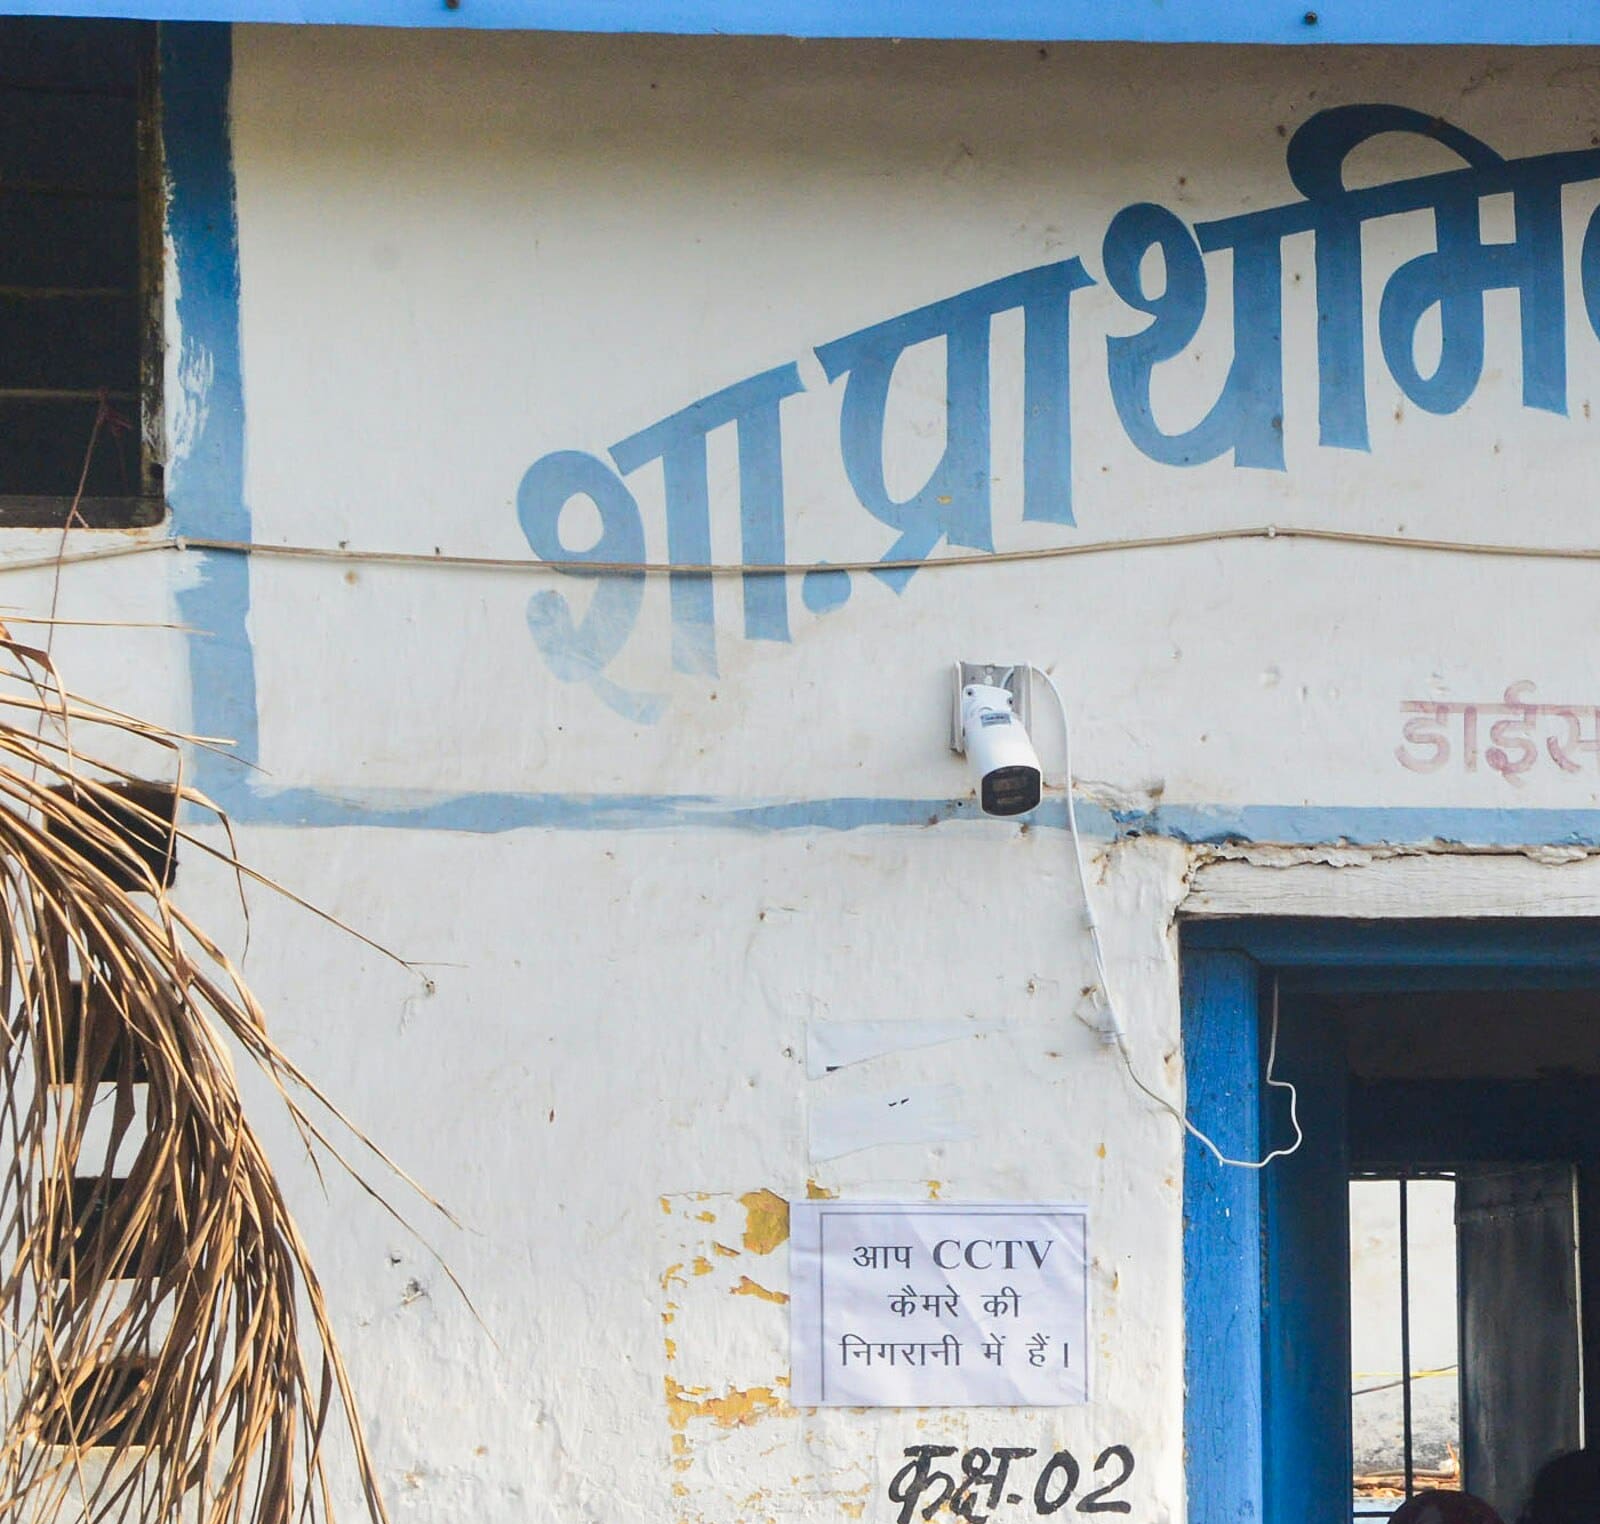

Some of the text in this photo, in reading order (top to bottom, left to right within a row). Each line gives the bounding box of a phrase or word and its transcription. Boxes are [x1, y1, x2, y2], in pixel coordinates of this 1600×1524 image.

[852, 1239, 1054, 1272] आप CCTV
[888, 1284, 1021, 1319] कैमरे की
[840, 1334, 962, 1368] निगरानी
[983, 1332, 1008, 1367] में
